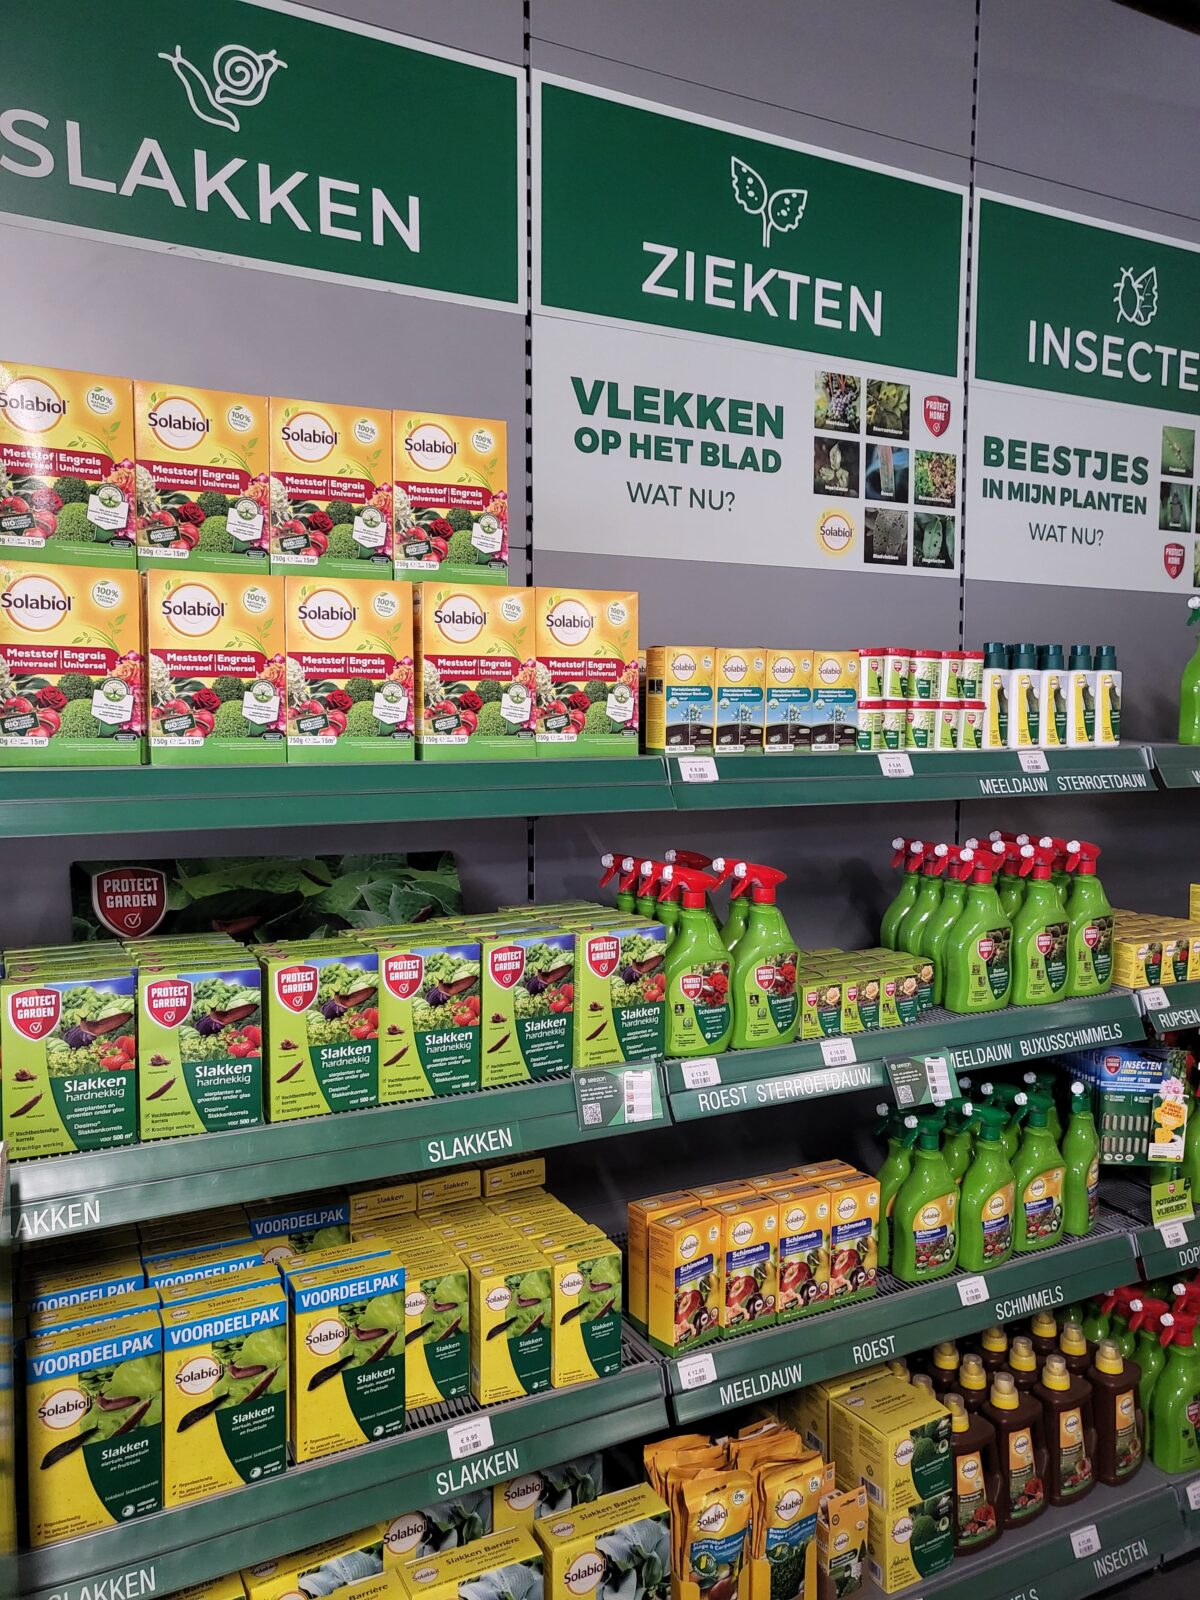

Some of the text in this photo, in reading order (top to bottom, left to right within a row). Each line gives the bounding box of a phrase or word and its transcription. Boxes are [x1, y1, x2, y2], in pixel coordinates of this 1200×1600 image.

[0, 109, 420, 253] SLAKKEN
[642, 241, 882, 337] ZIEKTEN
[91, 392, 113, 406] 100%
[571, 376, 784, 440] VLEKKEN
[926, 402, 948, 412] PROTECT
[148, 412, 210, 433] Solabiol
[231, 410, 251, 424] 100%
[929, 411, 945, 421] HOME
[282, 428, 338, 445] Solabiol
[358, 424, 375, 435] 100%
[405, 438, 457, 455] Solabiol
[475, 434, 492, 445] 100%
[4, 448, 101, 465] Meststof Engrais
[574, 427, 781, 473] OP HET BLAD
[4, 459, 101, 475] Universeel Universel
[984, 435, 1148, 485] BEESTJES
[153, 465, 240, 481] Meststof Engrais
[153, 475, 240, 489] Universeel Universel
[286, 476, 365, 491] Meststof Engrais
[286, 486, 365, 499] Universeel Universel
[408, 485, 482, 499] Meststof Engrais
[626, 481, 735, 512] WAT NU?
[982, 478, 1146, 515] IN MIJN PLANTEN
[408, 495, 482, 506] Universeel Universel
[1029, 522, 1104, 546] WAT NU?
[139, 548, 154, 556] 750g
[273, 556, 285, 564] 750g
[396, 561, 409, 569] 750g
[96, 586, 119, 598] 100%
[246, 593, 266, 604] 100%
[1, 592, 72, 611] Solabiol
[162, 600, 225, 617] Solabiol
[377, 598, 396, 609] 100%
[299, 606, 356, 621] Solabiol
[434, 610, 487, 625] Solabiol
[546, 615, 594, 628] Solabiol
[7, 648, 106, 661] Meststof Engrais
[167, 653, 255, 665] Meststof Engrais
[302, 656, 385, 667] Meststof Engrais
[8, 660, 106, 670] Universeel Universel
[167, 664, 212, 672] Universeel
[302, 666, 385, 675] Universeel Universel
[438, 658, 512, 670] Meststof Engrais
[549, 660, 616, 670] Meststof Engrais
[153, 738, 168, 746] 750g
[979, 774, 1146, 795] MEELDAUW STERROETDAUW
[104, 878, 158, 893] PROTECT
[106, 895, 157, 909] GARDEN
[591, 941, 617, 951] PROTECT
[494, 951, 522, 962] PROTECT
[592, 950, 615, 961] GARDEN
[388, 959, 419, 971] PROTECT
[495, 961, 520, 971] GARDEN
[281, 971, 314, 983] PROTECT
[390, 970, 418, 981] GARDEN
[151, 986, 188, 999] PROTECT
[283, 982, 312, 993] GARDEN
[15, 994, 56, 1008] PROTECT
[153, 997, 186, 1010] GARDEN
[17, 1006, 54, 1020] GARDEN
[621, 1007, 660, 1020] Slakken
[1158, 1009, 1200, 1028] RUPSEN
[525, 1018, 566, 1032] Slakken
[622, 1016, 658, 1028] hardnekkig
[425, 1031, 472, 1046] Slakken
[526, 1028, 565, 1040] hardnekkig
[1020, 1023, 1122, 1057] BUXUSSCHIMMELS
[320, 1045, 371, 1060] Slakken
[426, 1040, 471, 1054] hardnekkig
[322, 1055, 370, 1069] hardnekkig
[1123, 1061, 1162, 1070] INSECTEN
[195, 1063, 252, 1079] Slakken
[64, 1075, 126, 1094] Slakken
[197, 1074, 250, 1088] hardnekkig
[66, 1087, 125, 1102] hardnekkig
[699, 1086, 747, 1112] ROEST
[757, 1067, 872, 1103] STERROETDAUW
[428, 1128, 513, 1163] SLAKKEN
[1155, 1194, 1187, 1206] POTGROND
[1157, 1203, 1187, 1215] VLIEGJES?
[15, 1200, 100, 1238] AKKEN
[256, 1208, 343, 1235] VOORDEELPAK
[837, 1220, 866, 1233] Schimmels
[786, 1232, 816, 1245] Schimmels
[732, 1245, 764, 1259] Schimmels
[680, 1256, 708, 1272] Schimmels
[301, 1274, 399, 1307] VOORDEELPAK
[171, 1307, 279, 1344] VOORDEELPAK
[306, 1329, 348, 1345] Solabiol
[720, 1286, 1064, 1401] MEELDAUW ROEST SCHIMMELS
[33, 1334, 153, 1376] VOORDEELPAK
[176, 1365, 222, 1384] Solabiol
[357, 1367, 395, 1384] Slakken
[38, 1398, 90, 1418] Solabiol
[232, 1406, 275, 1425] Slakken
[465, 1434, 478, 1442] 9,95
[101, 1439, 149, 1459] Slakken
[437, 1448, 519, 1495] SLAKKEN
[504, 1479, 544, 1502] Solabiol
[580, 1493, 646, 1522] Slakken Barrière
[484, 1537, 520, 1552] Barrière
[1093, 1540, 1148, 1578] INSECTEN
[564, 1561, 606, 1584] Solabiol
[48, 1566, 156, 1600] AKKEN
